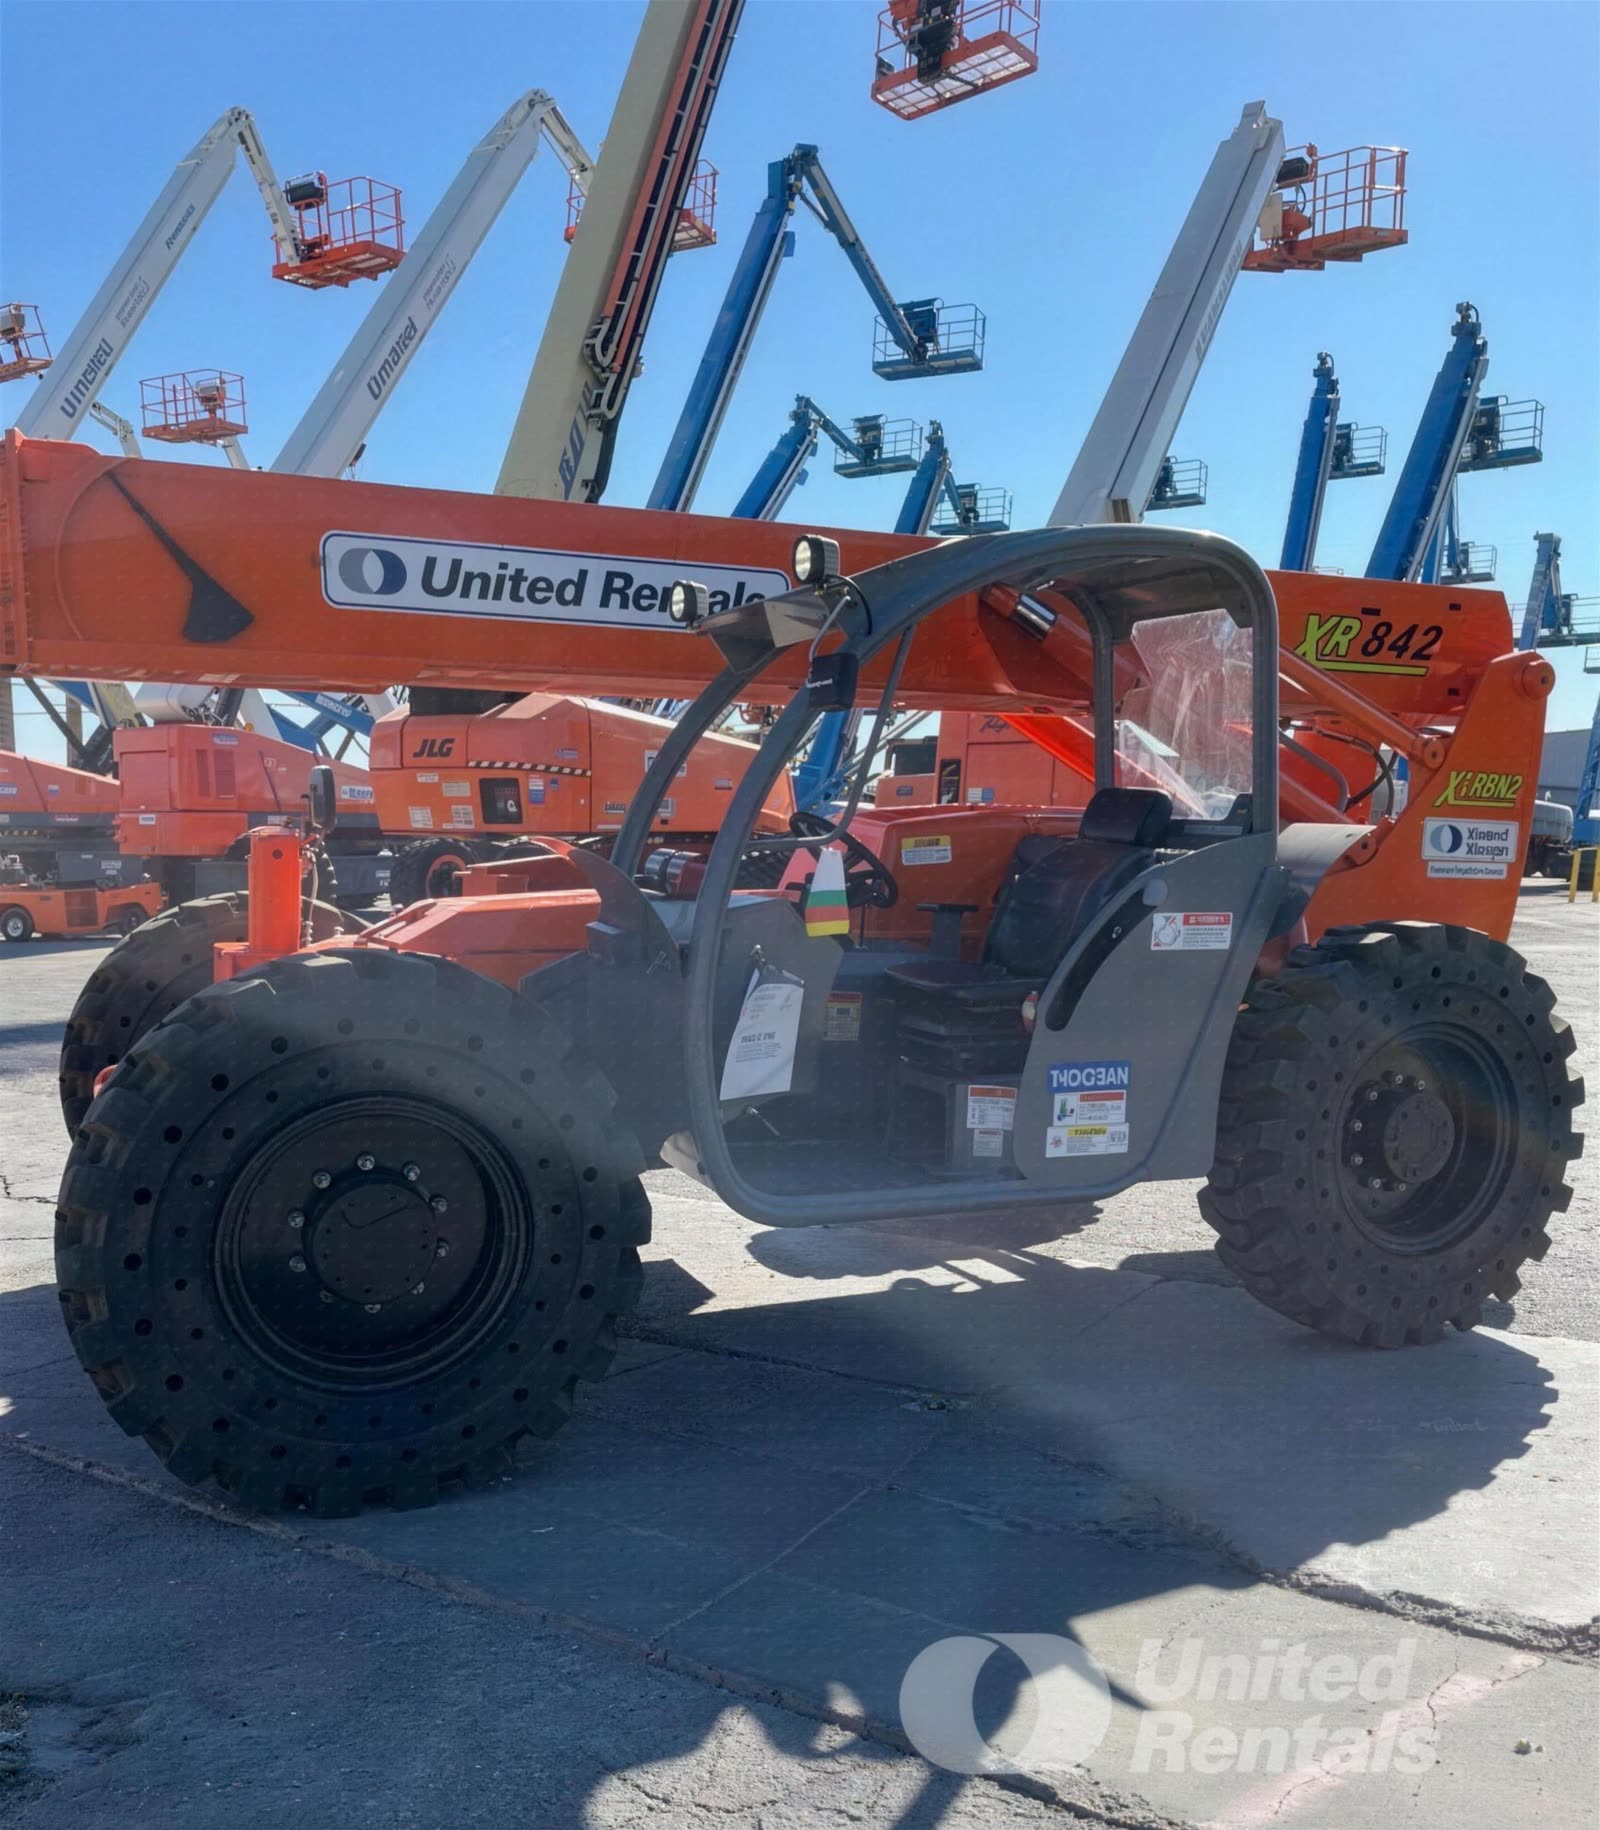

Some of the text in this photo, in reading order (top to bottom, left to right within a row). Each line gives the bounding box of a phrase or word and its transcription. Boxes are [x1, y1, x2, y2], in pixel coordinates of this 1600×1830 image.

[420, 556, 766, 615] United Real
[1295, 613, 1444, 663] XR 842
[412, 738, 455, 758] JLG
